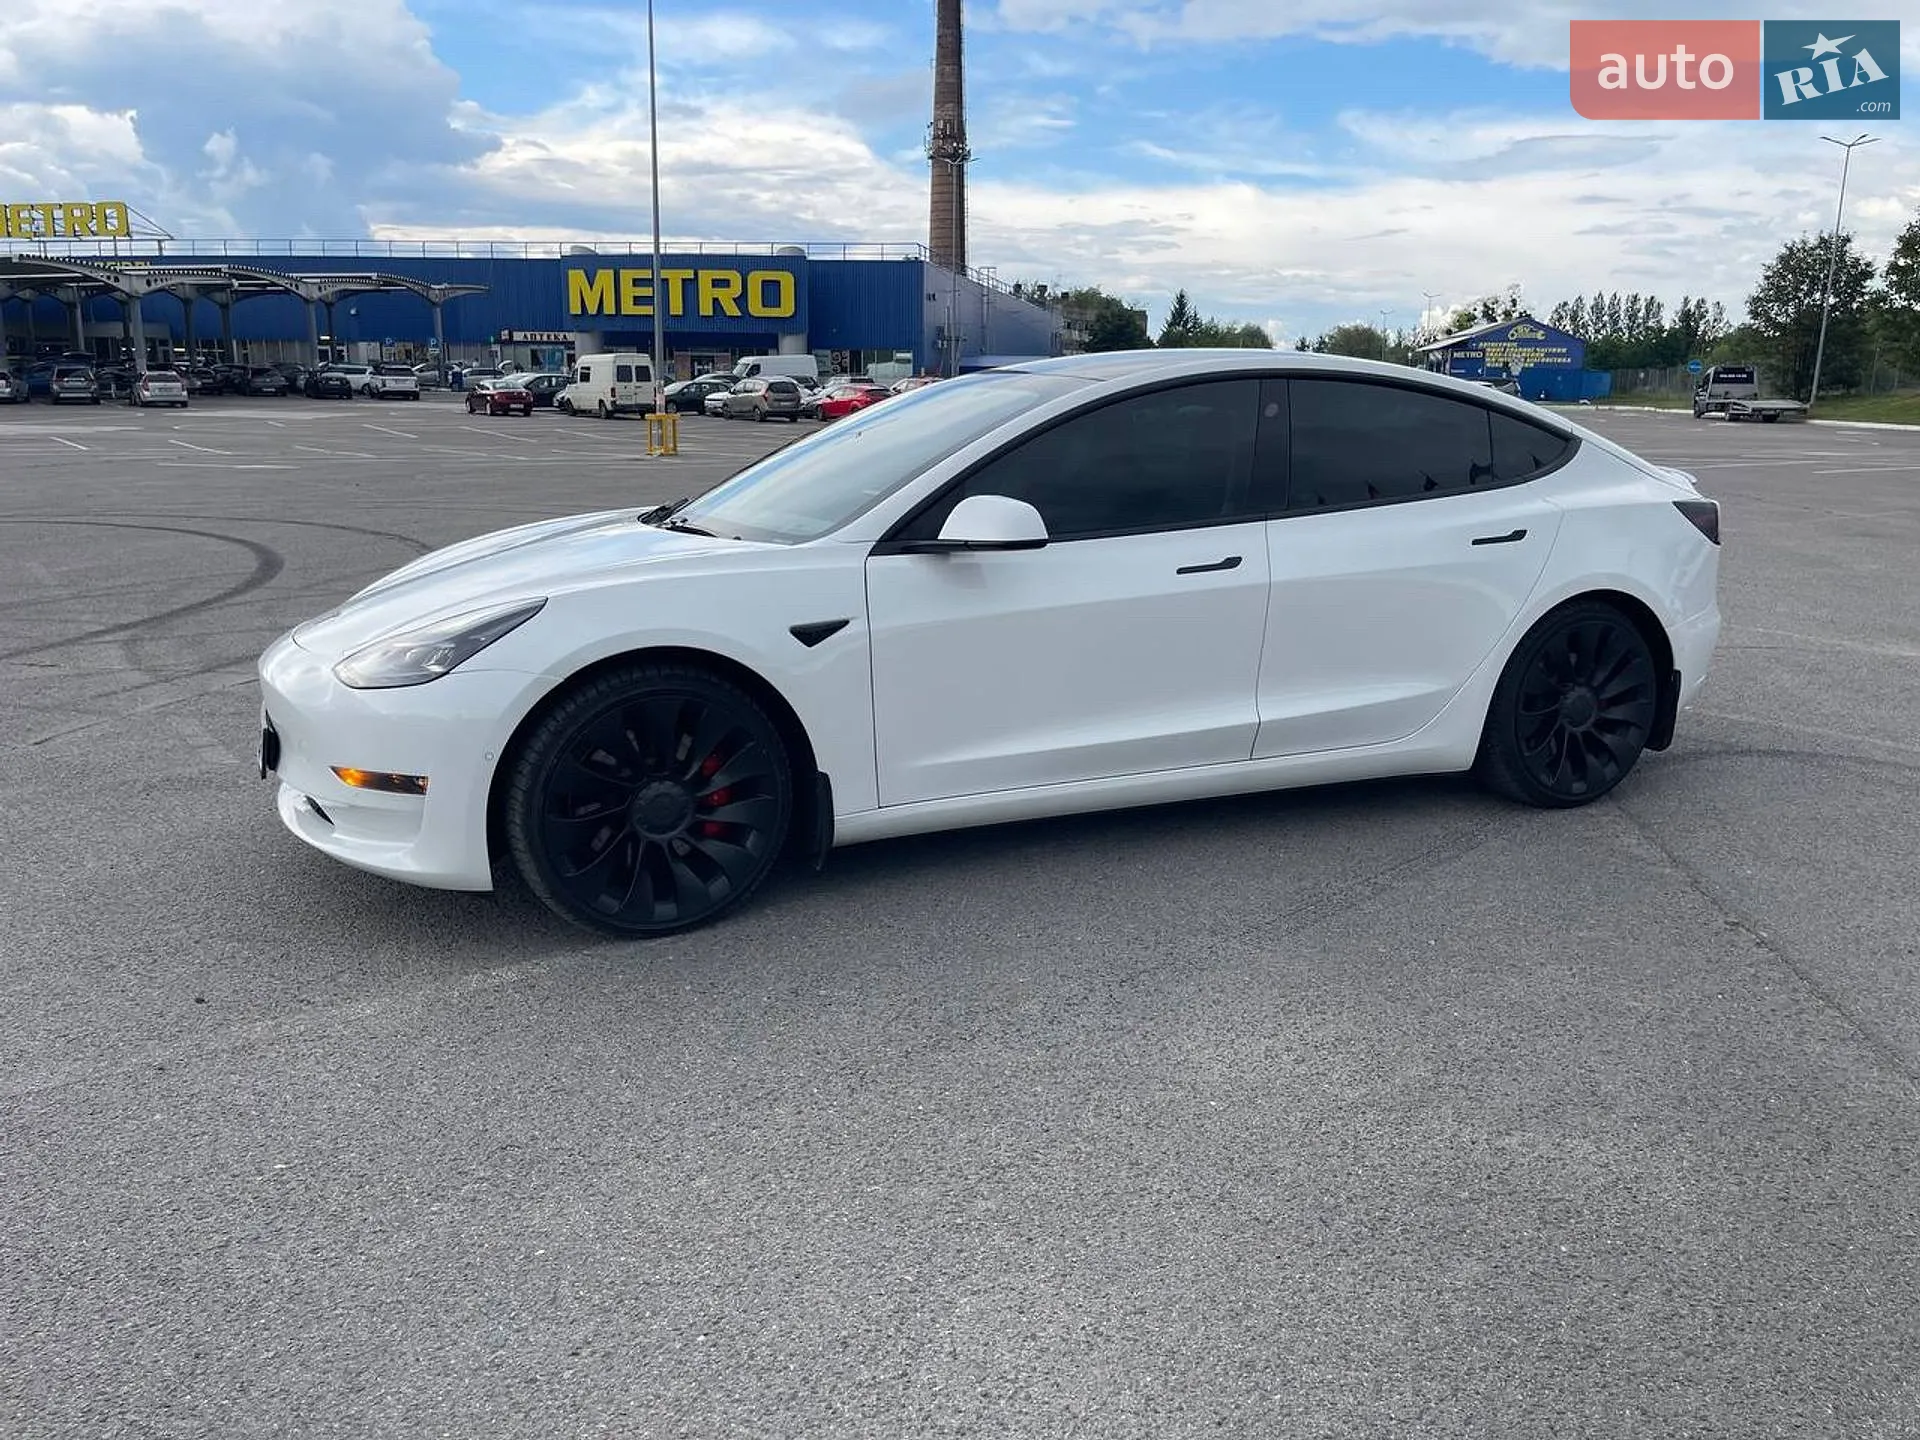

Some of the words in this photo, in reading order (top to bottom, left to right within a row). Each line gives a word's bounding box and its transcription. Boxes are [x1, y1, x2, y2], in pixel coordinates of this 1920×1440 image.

[0, 202, 129, 238] ETRO
[568, 269, 795, 317] METRO
[522, 332, 569, 341] АПТЕКА
